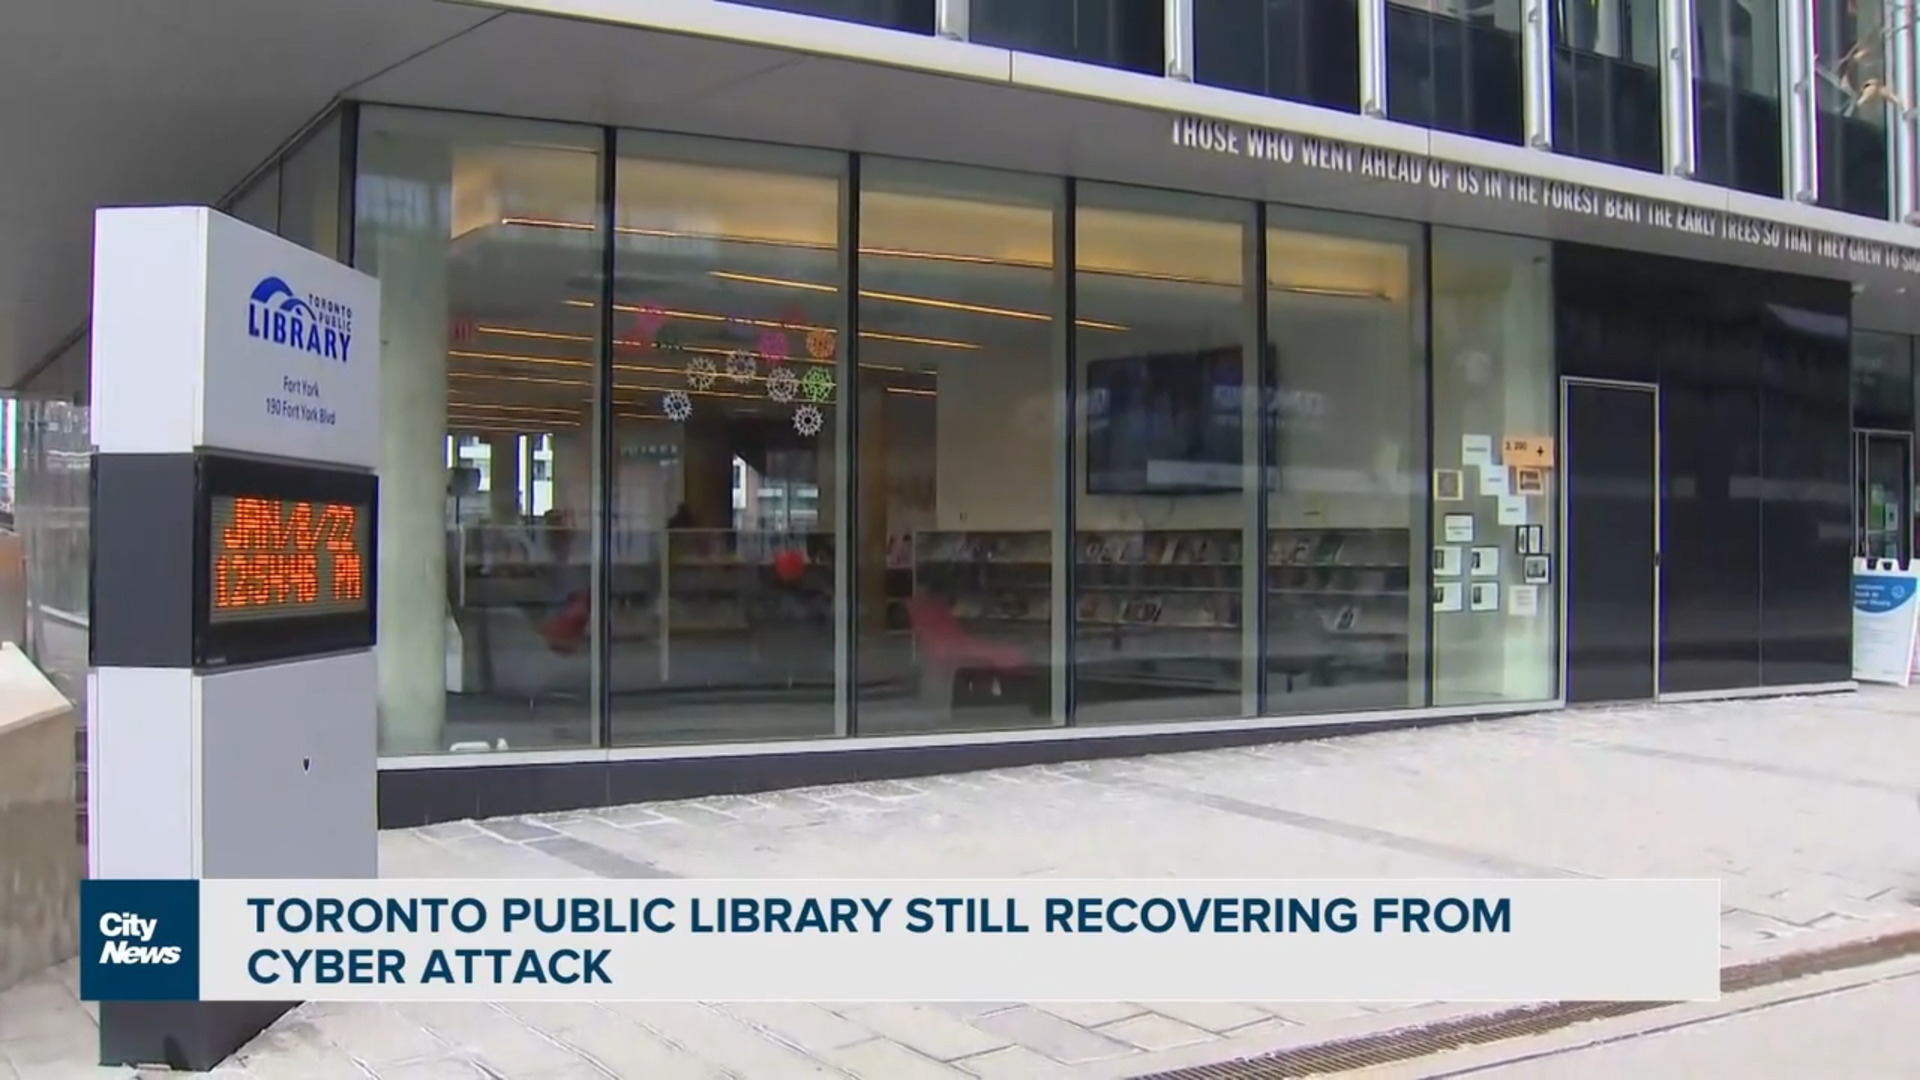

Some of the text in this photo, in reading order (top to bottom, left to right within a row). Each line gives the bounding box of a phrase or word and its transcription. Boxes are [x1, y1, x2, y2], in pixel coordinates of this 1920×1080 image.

[1172, 117, 1239, 154] THOSE
[1248, 129, 1294, 164] WHO
[1302, 138, 1353, 173] WENT
[1361, 148, 1422, 184] AHEAD
[1429, 159, 1450, 189] OF
[1457, 167, 1479, 195] US
[1485, 171, 1502, 199] IN
[1509, 174, 1538, 204] THE
[1544, 182, 1599, 215] FOREST
[1606, 192, 1641, 223] BENT
[1648, 201, 1673, 228] THE
[1677, 206, 1717, 236] EARLY
[1721, 216, 1760, 244] TREES
[1762, 224, 1780, 248] SO
[1784, 228, 1813, 255] THAT
[1817, 234, 1845, 260] THEY
[308, 293, 352, 319] TORONTO
[249, 303, 351, 363] LIBRARY
[319, 312, 352, 333] PUBLIC
[283, 375, 319, 398] Fort York
[266, 398, 336, 426] 190 Fort York Blvd
